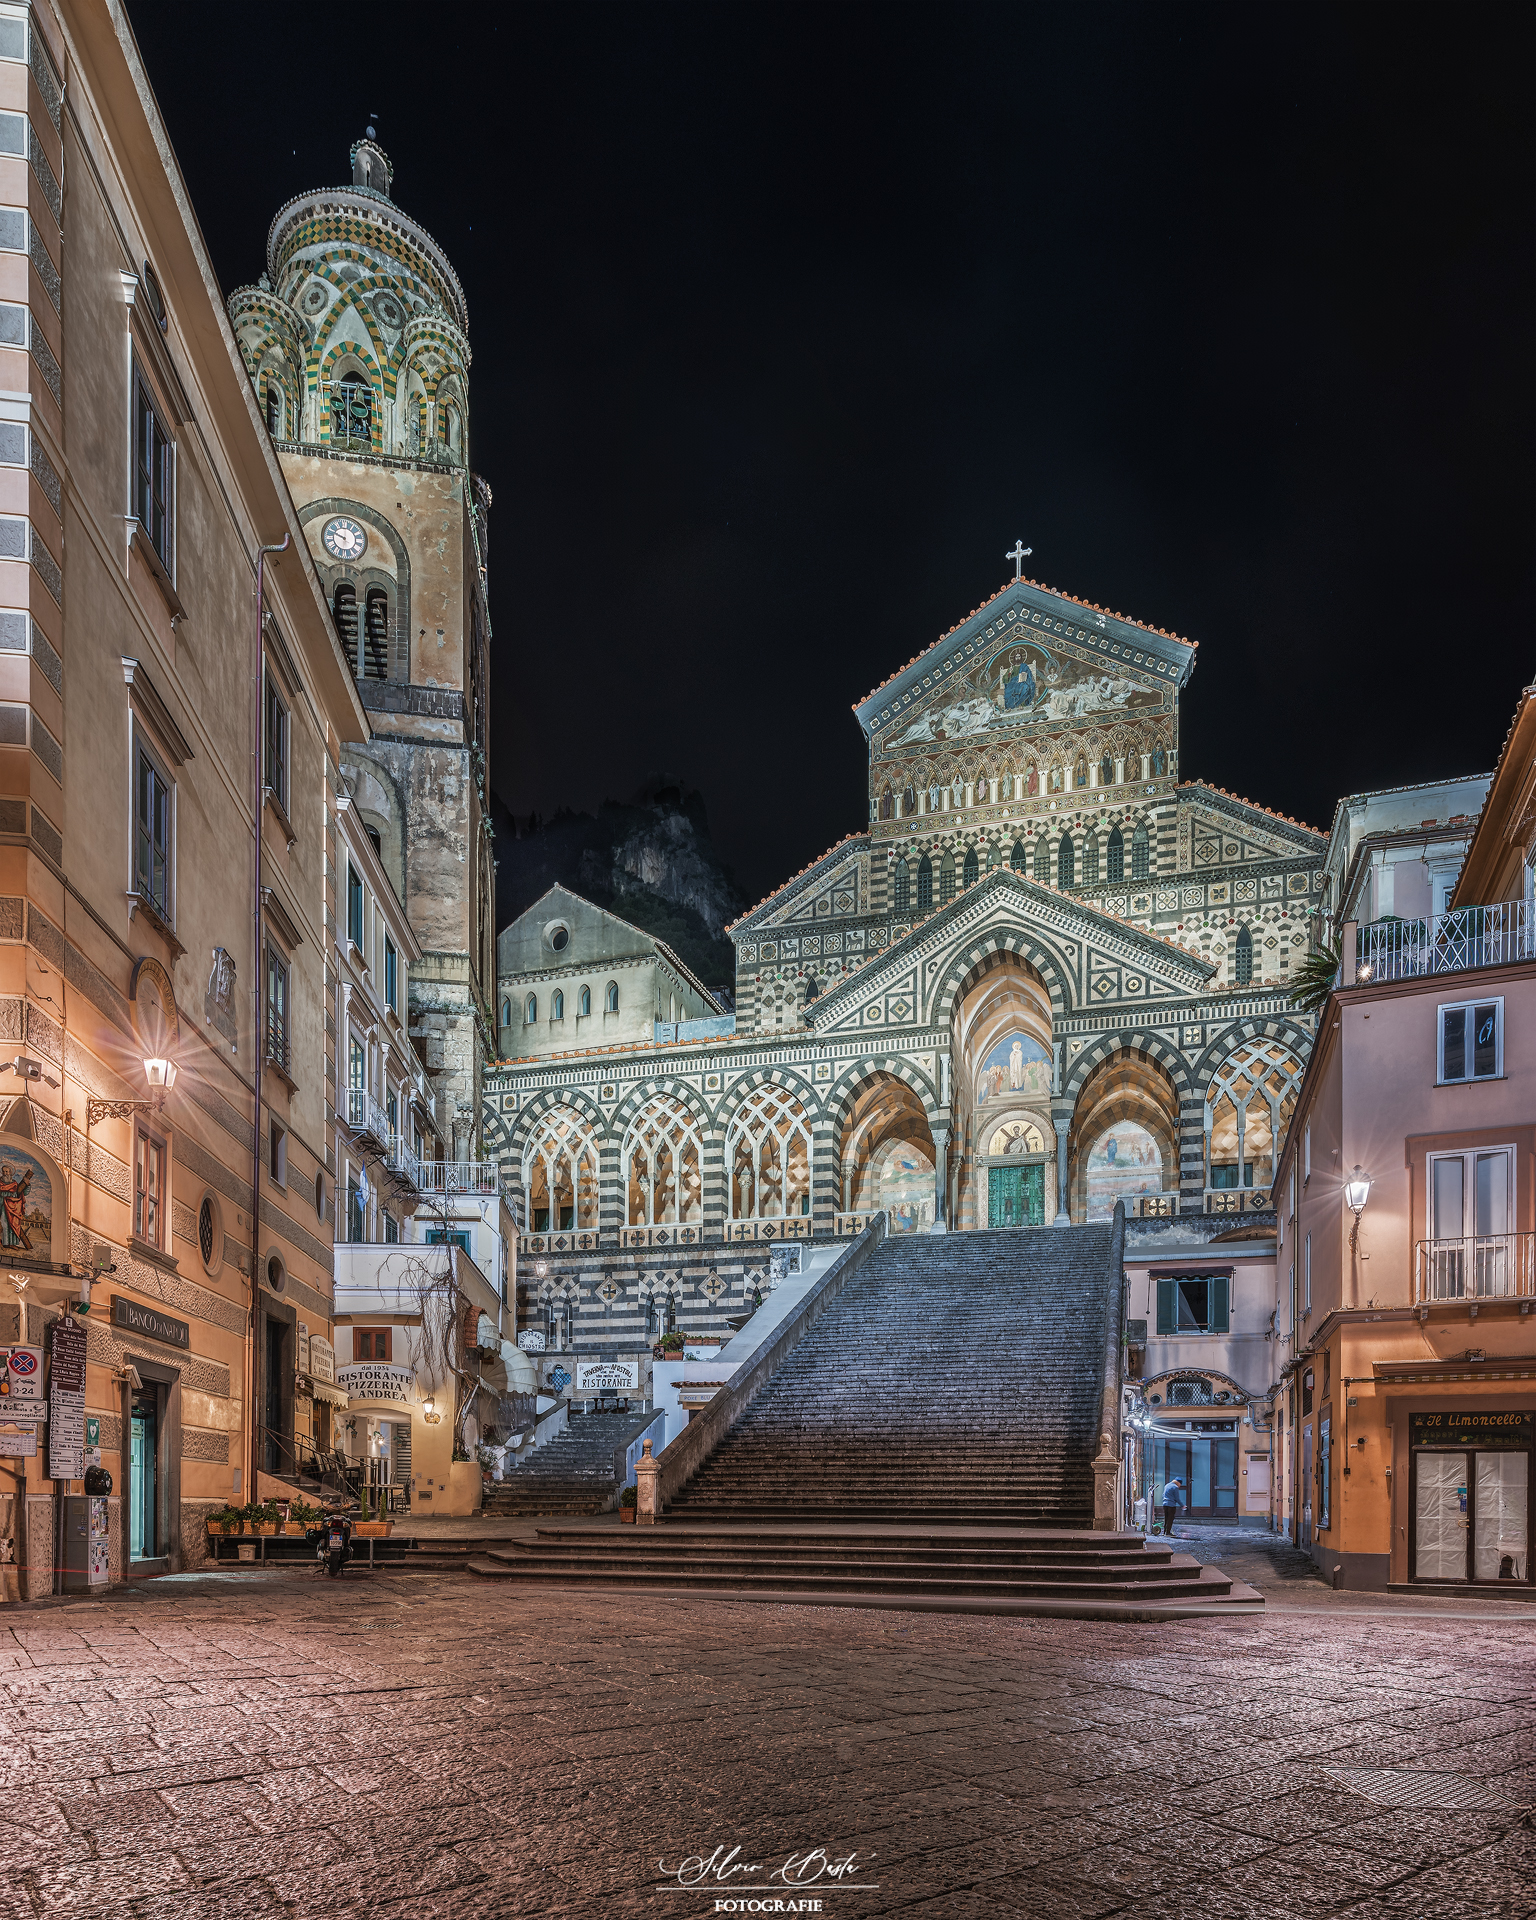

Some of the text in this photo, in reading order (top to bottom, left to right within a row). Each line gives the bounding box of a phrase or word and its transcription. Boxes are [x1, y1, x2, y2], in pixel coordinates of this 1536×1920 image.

[129, 1307, 156, 1332] BANCO
[163, 1321, 188, 1343] NAPOLI
[338, 1371, 413, 1385] RISTORANTE
[582, 1378, 632, 1389] RISTORANTE
[347, 1380, 402, 1391] PIZZERIA
[358, 1389, 408, 1403] ANDREA
[1426, 1413, 1522, 1426] Il Limoncello
